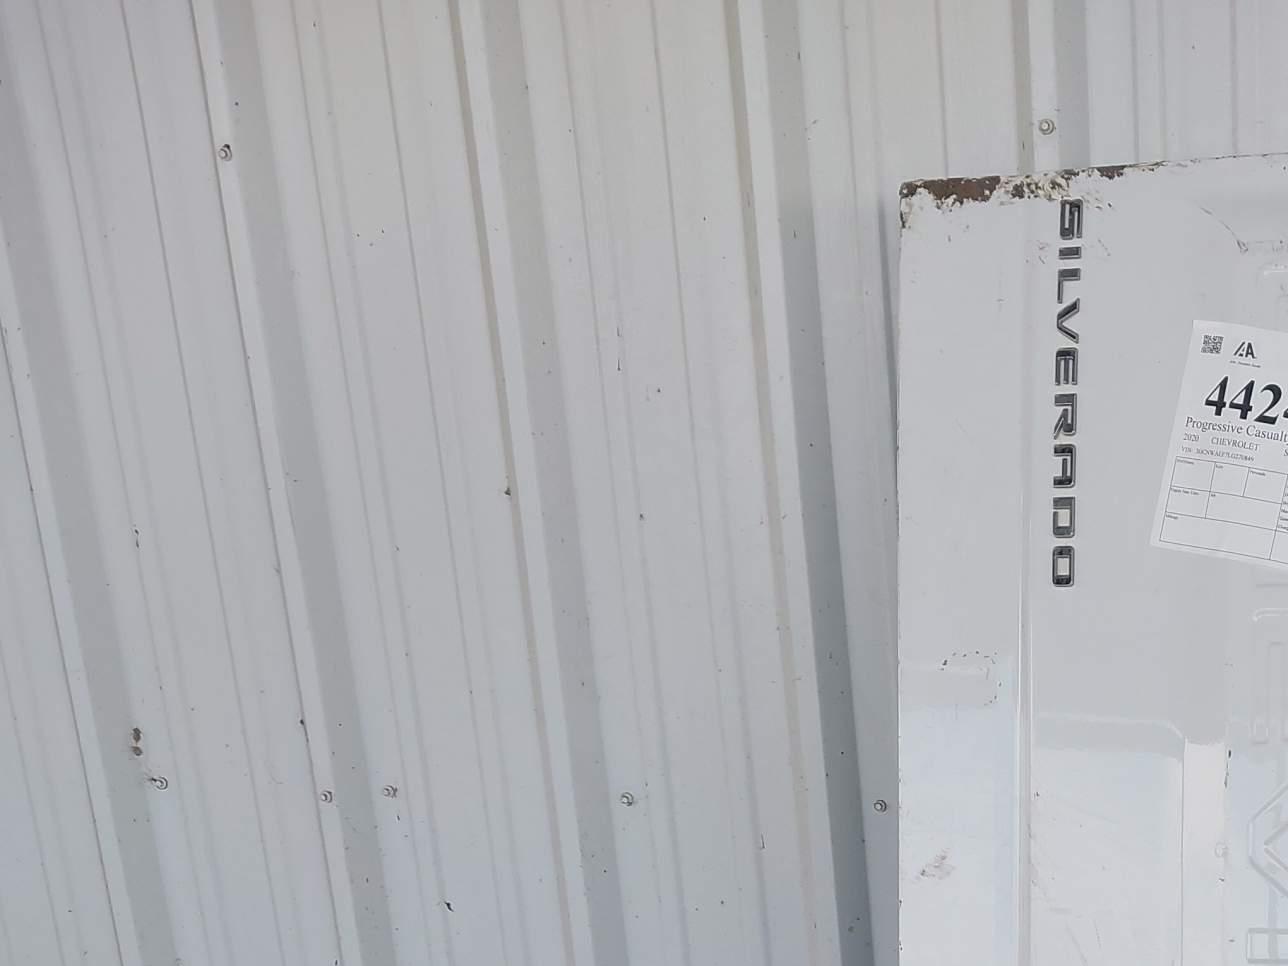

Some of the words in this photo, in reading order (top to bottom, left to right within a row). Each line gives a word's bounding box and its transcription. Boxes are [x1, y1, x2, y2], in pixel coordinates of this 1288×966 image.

[1051, 199, 1083, 588] SILVERADO
[1185, 416, 1244, 434] Progressive
[1183, 432, 1200, 442] 2020
[1210, 436, 1259, 451] CHEVROLET
